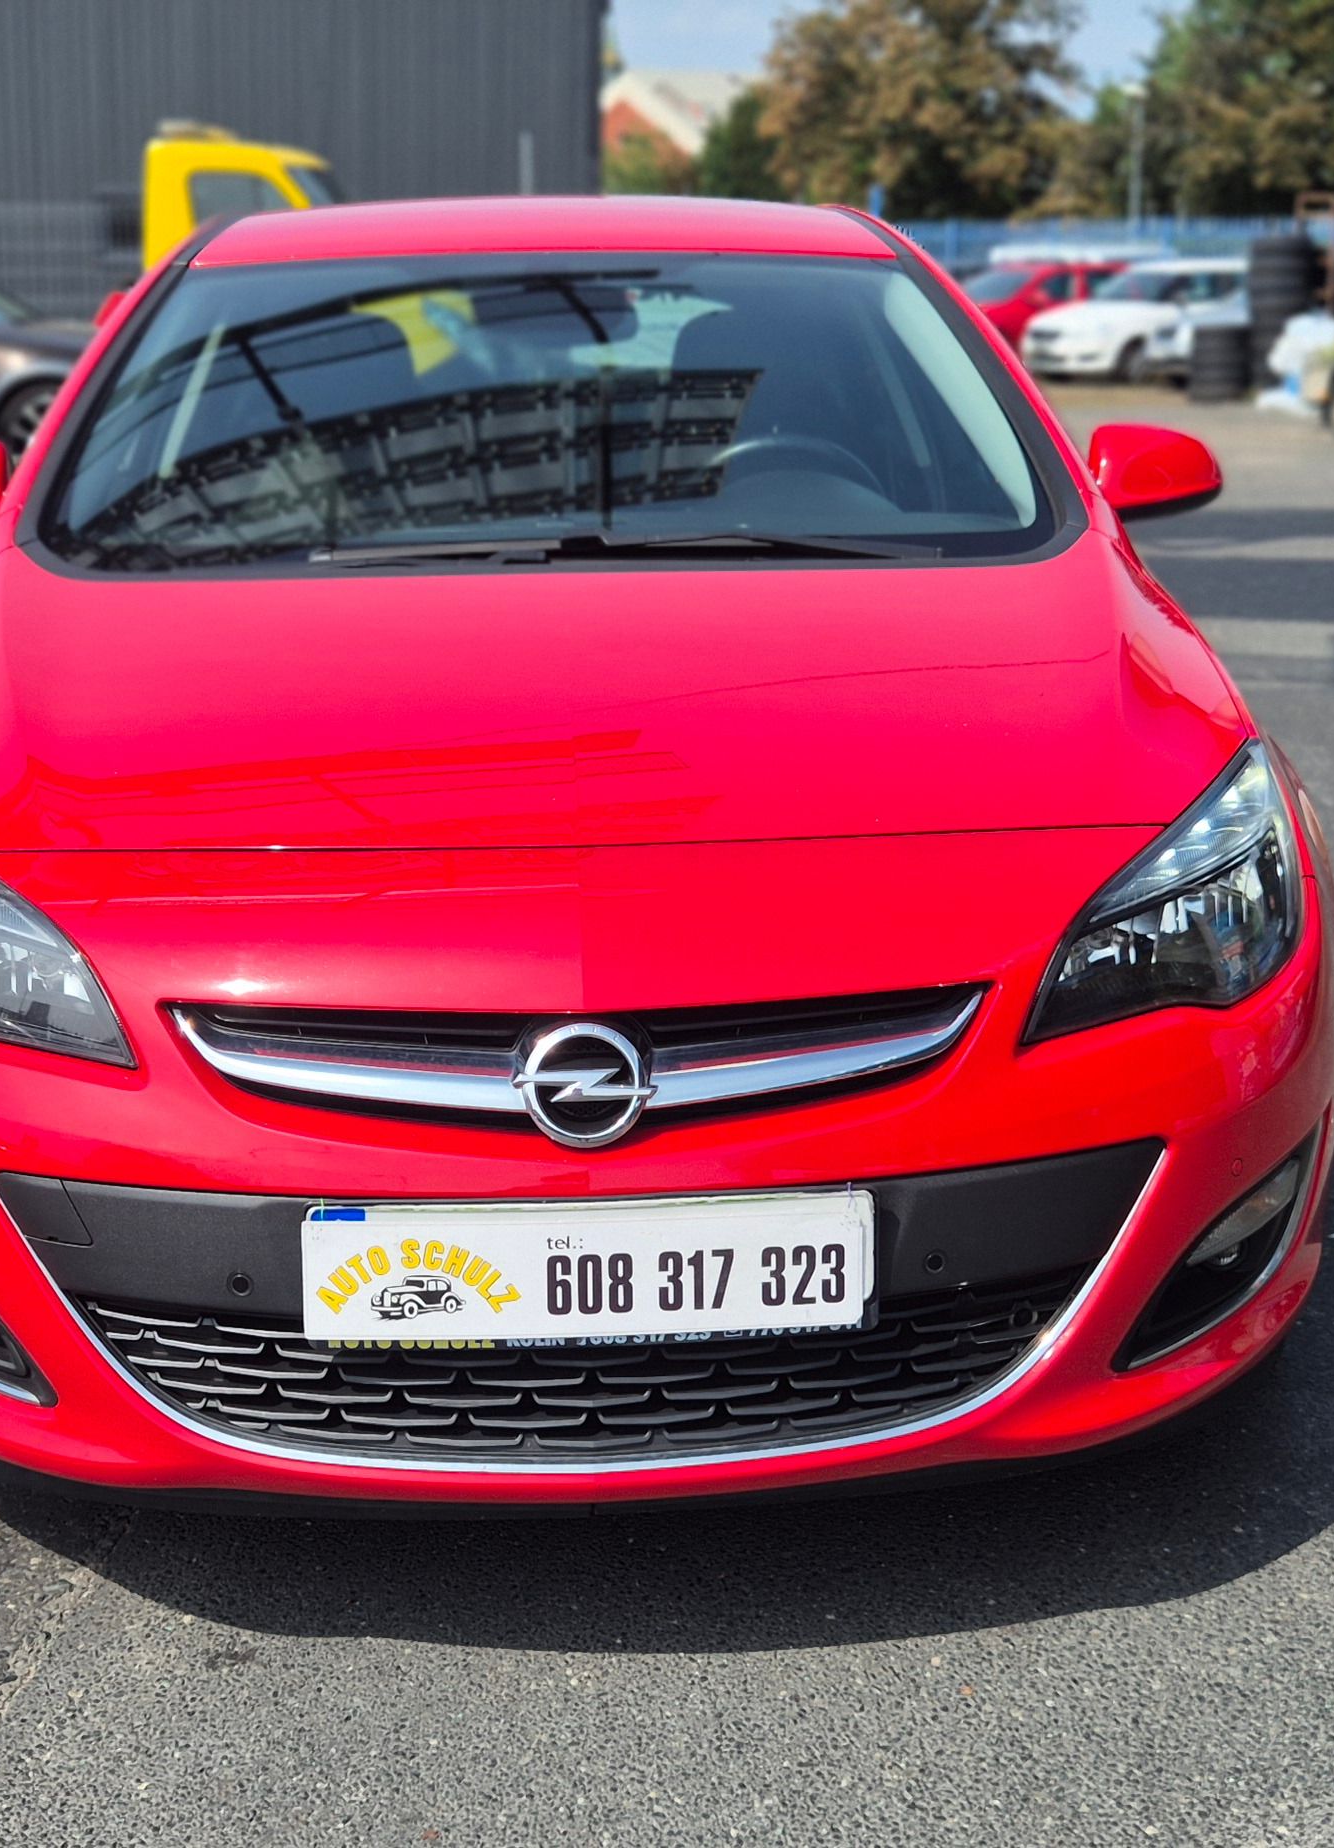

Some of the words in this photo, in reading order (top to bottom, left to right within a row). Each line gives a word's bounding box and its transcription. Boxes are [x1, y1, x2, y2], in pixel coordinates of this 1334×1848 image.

[316, 1245, 391, 1315] AUTO
[400, 1238, 522, 1314] SCHULZ
[546, 1236, 584, 1250] tel.:
[546, 1252, 634, 1316] 608
[658, 1248, 735, 1312] 317
[761, 1243, 846, 1307] 323
